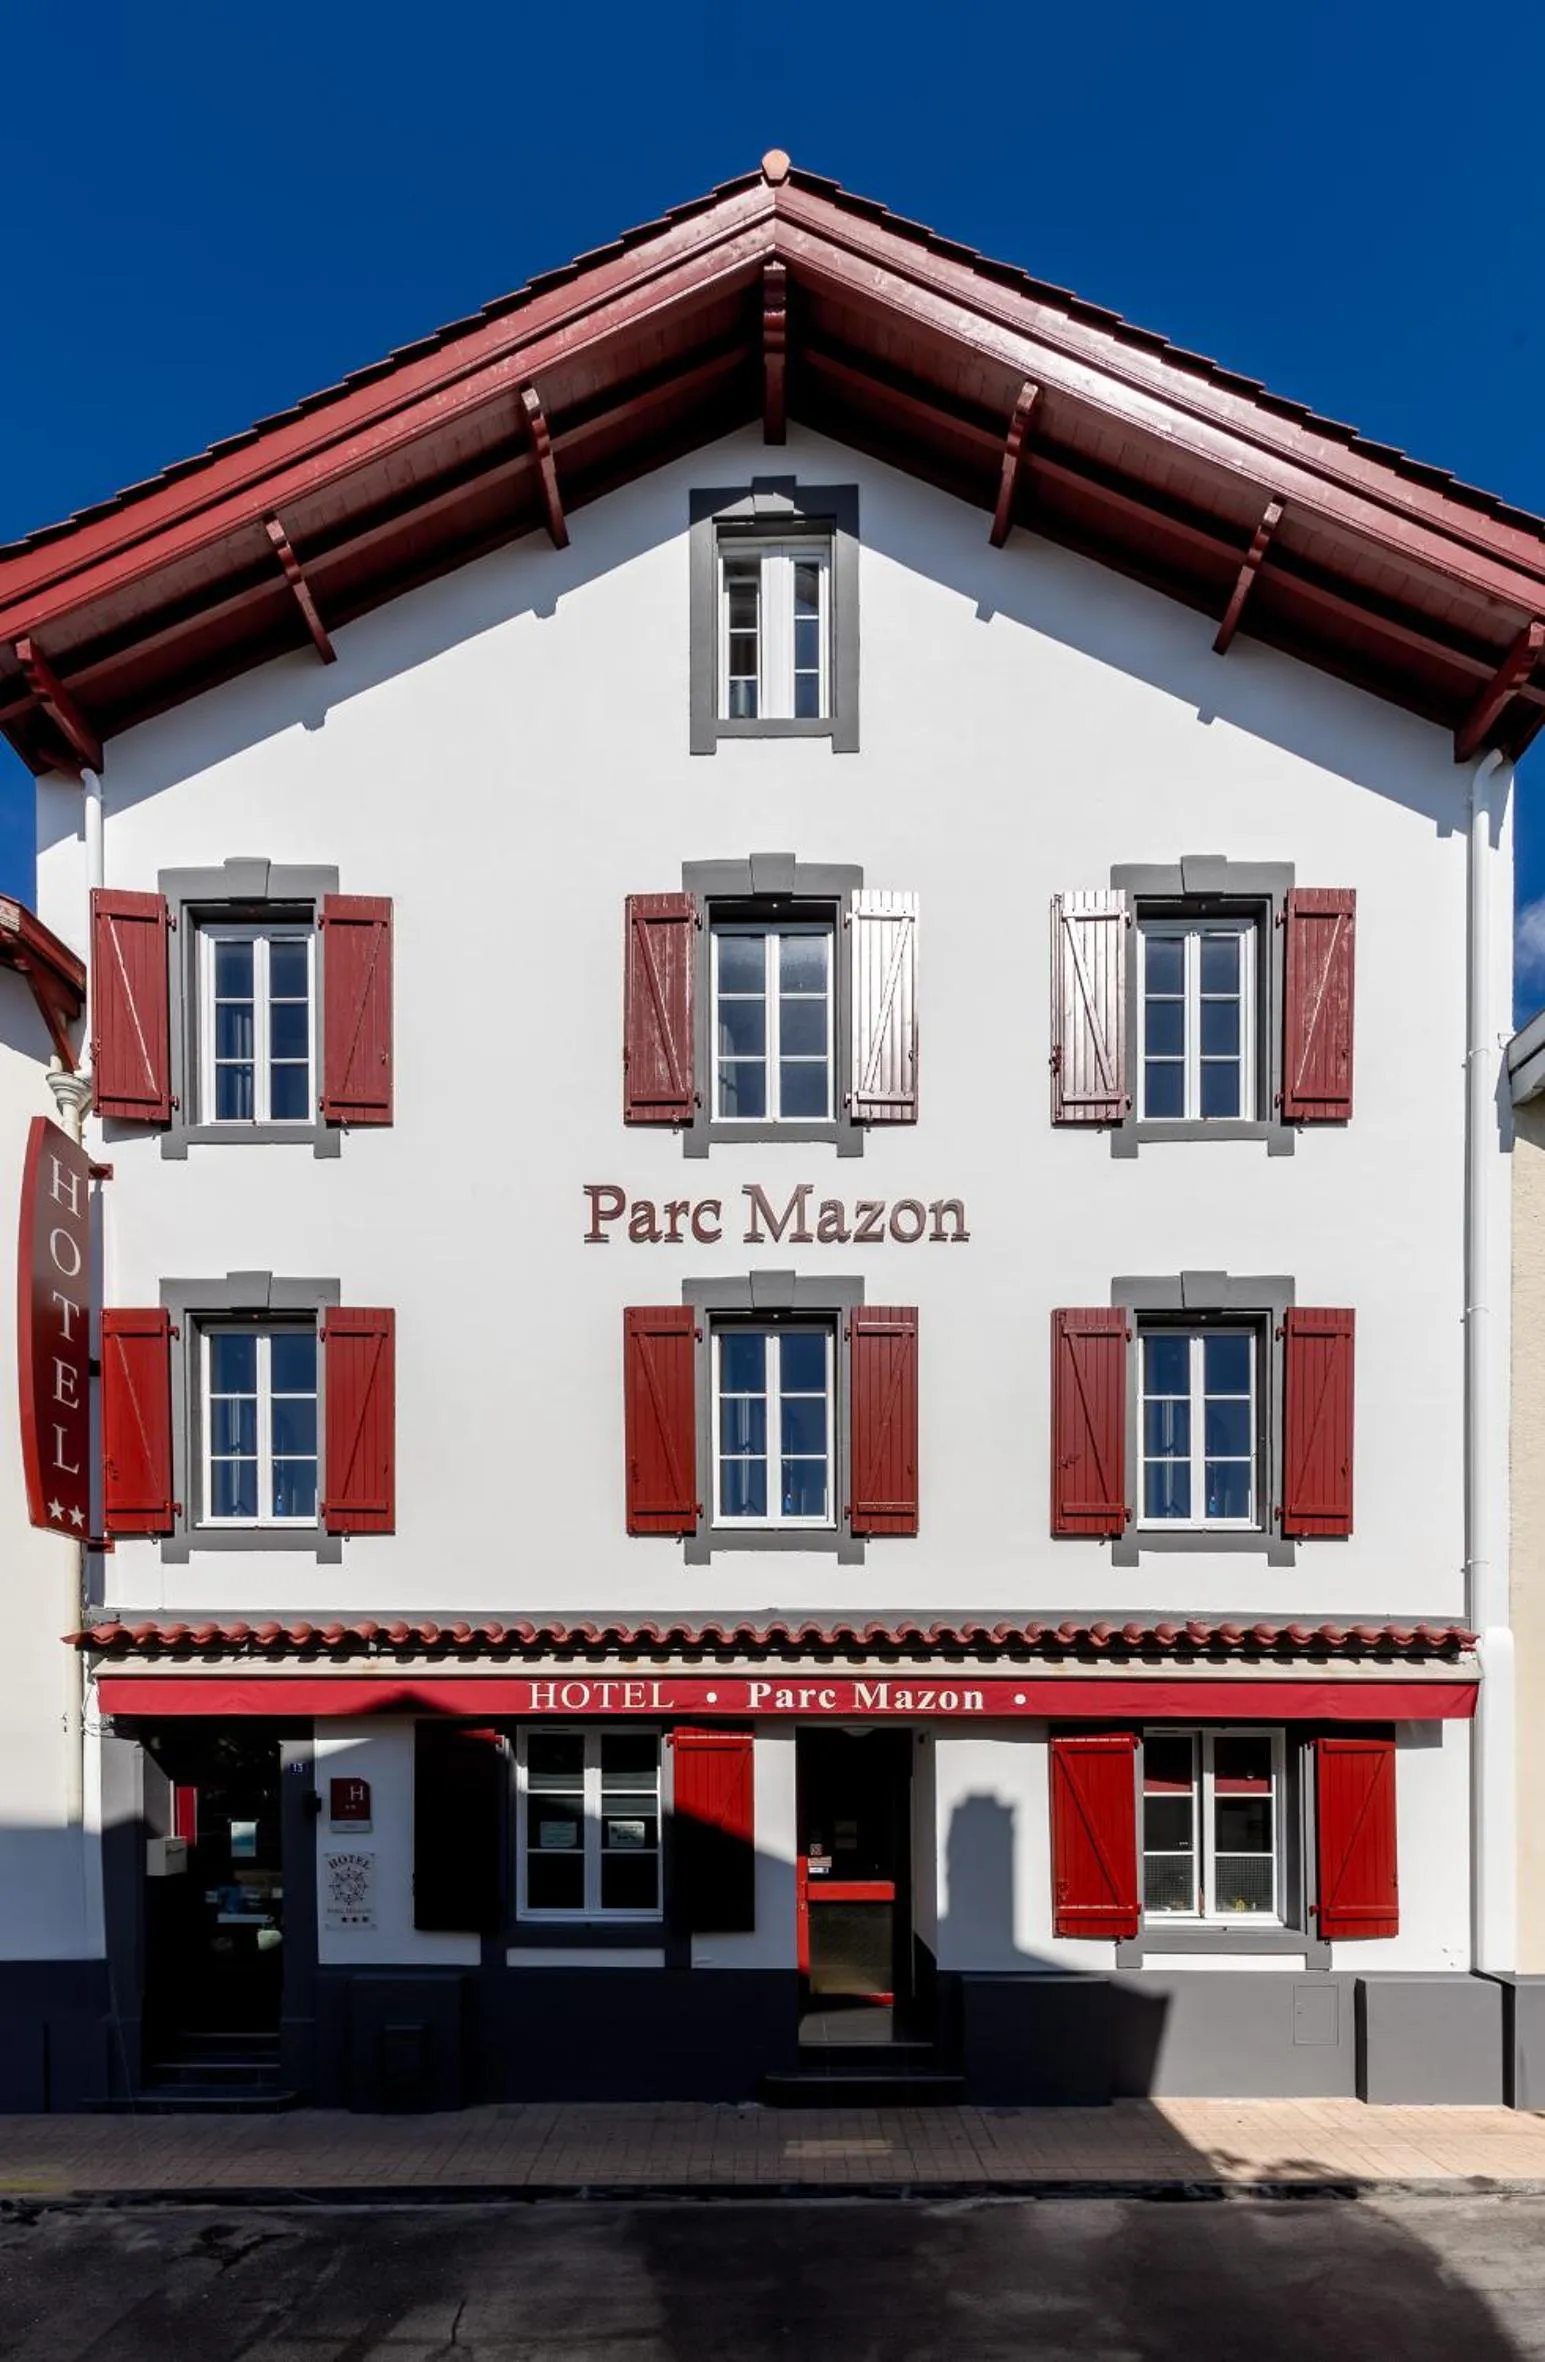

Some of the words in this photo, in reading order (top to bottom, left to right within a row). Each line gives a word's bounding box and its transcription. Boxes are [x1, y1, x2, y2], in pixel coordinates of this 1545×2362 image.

[583, 1184, 722, 1243] Parc
[742, 1184, 971, 1243] Mazon
[50, 1154, 82, 1474] HOTEL
[529, 1682, 674, 1709] HOTEL
[747, 1682, 836, 1709] Parc
[852, 1682, 984, 1710] Mazon
[350, 1785, 364, 1801] H
[328, 1854, 371, 1870] HOTEL
